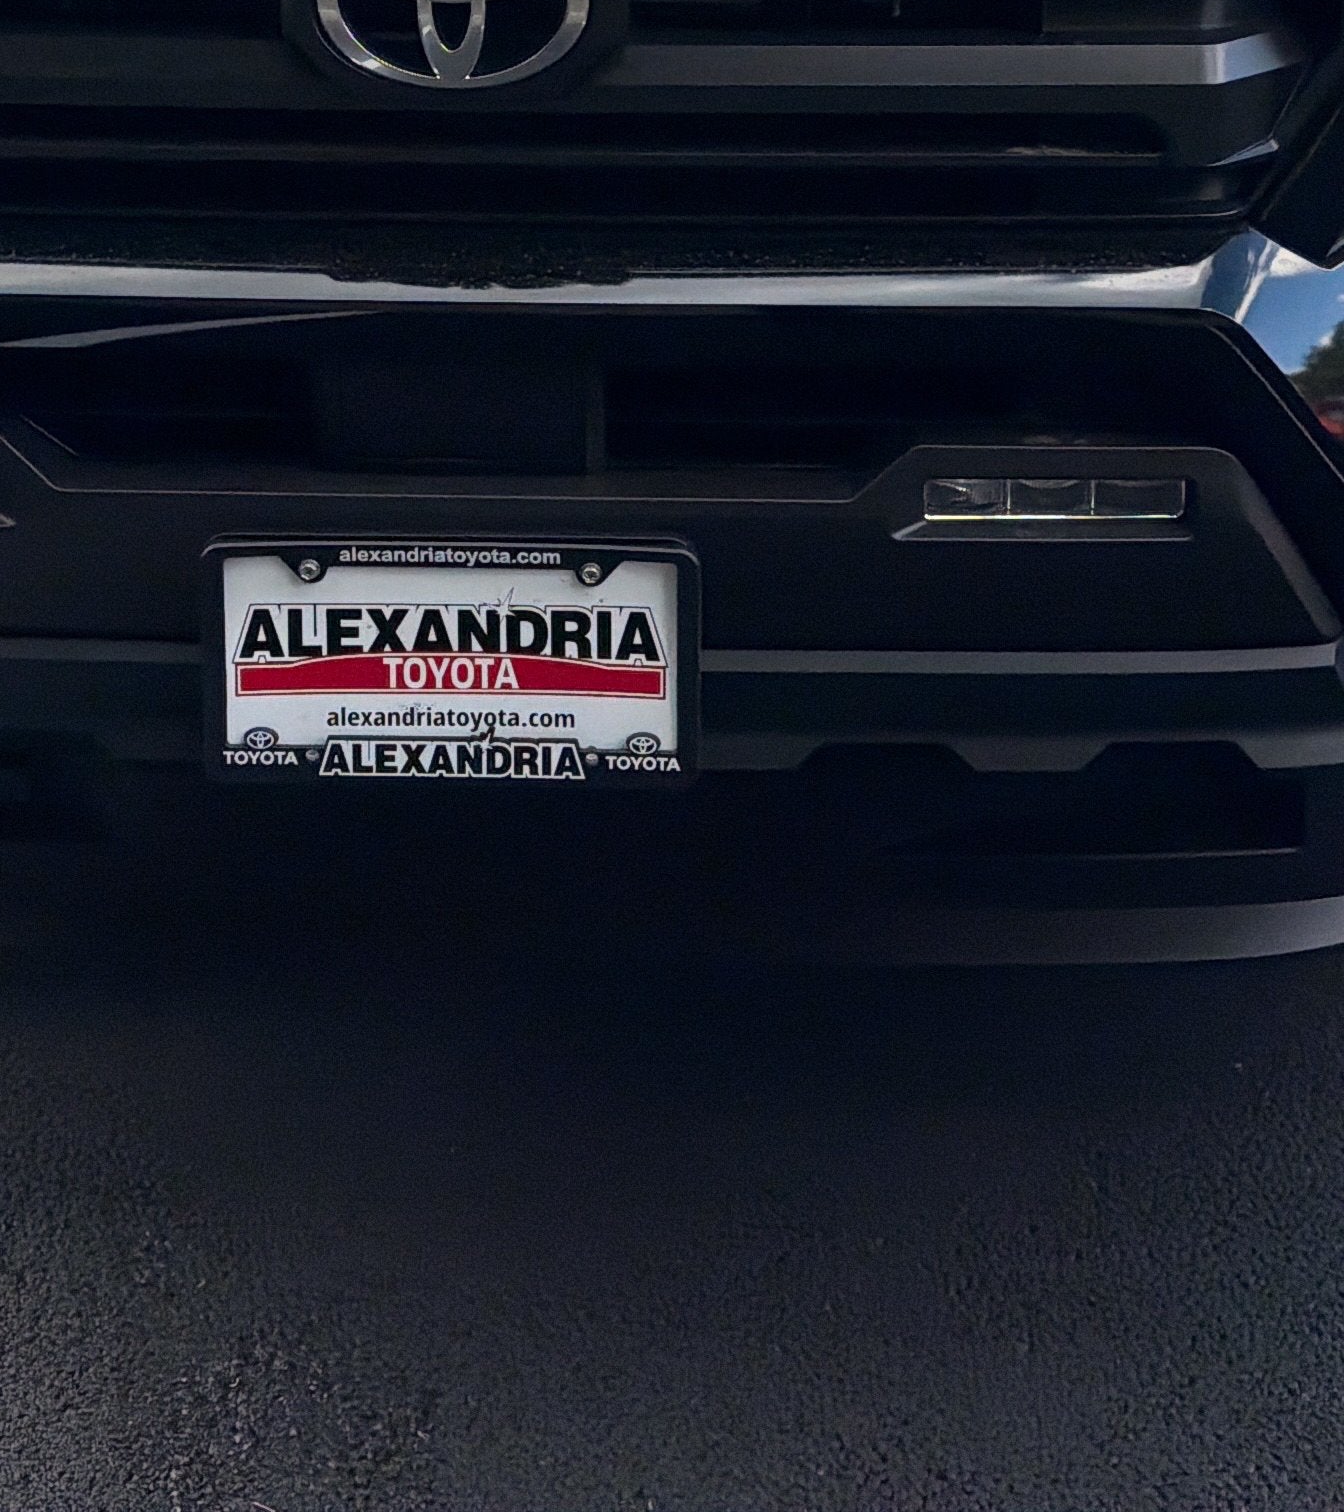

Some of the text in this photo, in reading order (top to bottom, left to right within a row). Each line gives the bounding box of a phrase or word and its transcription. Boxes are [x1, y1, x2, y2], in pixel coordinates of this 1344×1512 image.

[339, 547, 561, 567] alexandriatoyota.com
[236, 605, 664, 664] ALEXANDRIA
[383, 657, 520, 690] TOYOTA
[327, 707, 575, 732] alexandriatoyota.com
[223, 750, 299, 767] TOYOTA
[319, 739, 586, 780] ALEXANDRIA
[605, 755, 682, 772] TOYOTA
